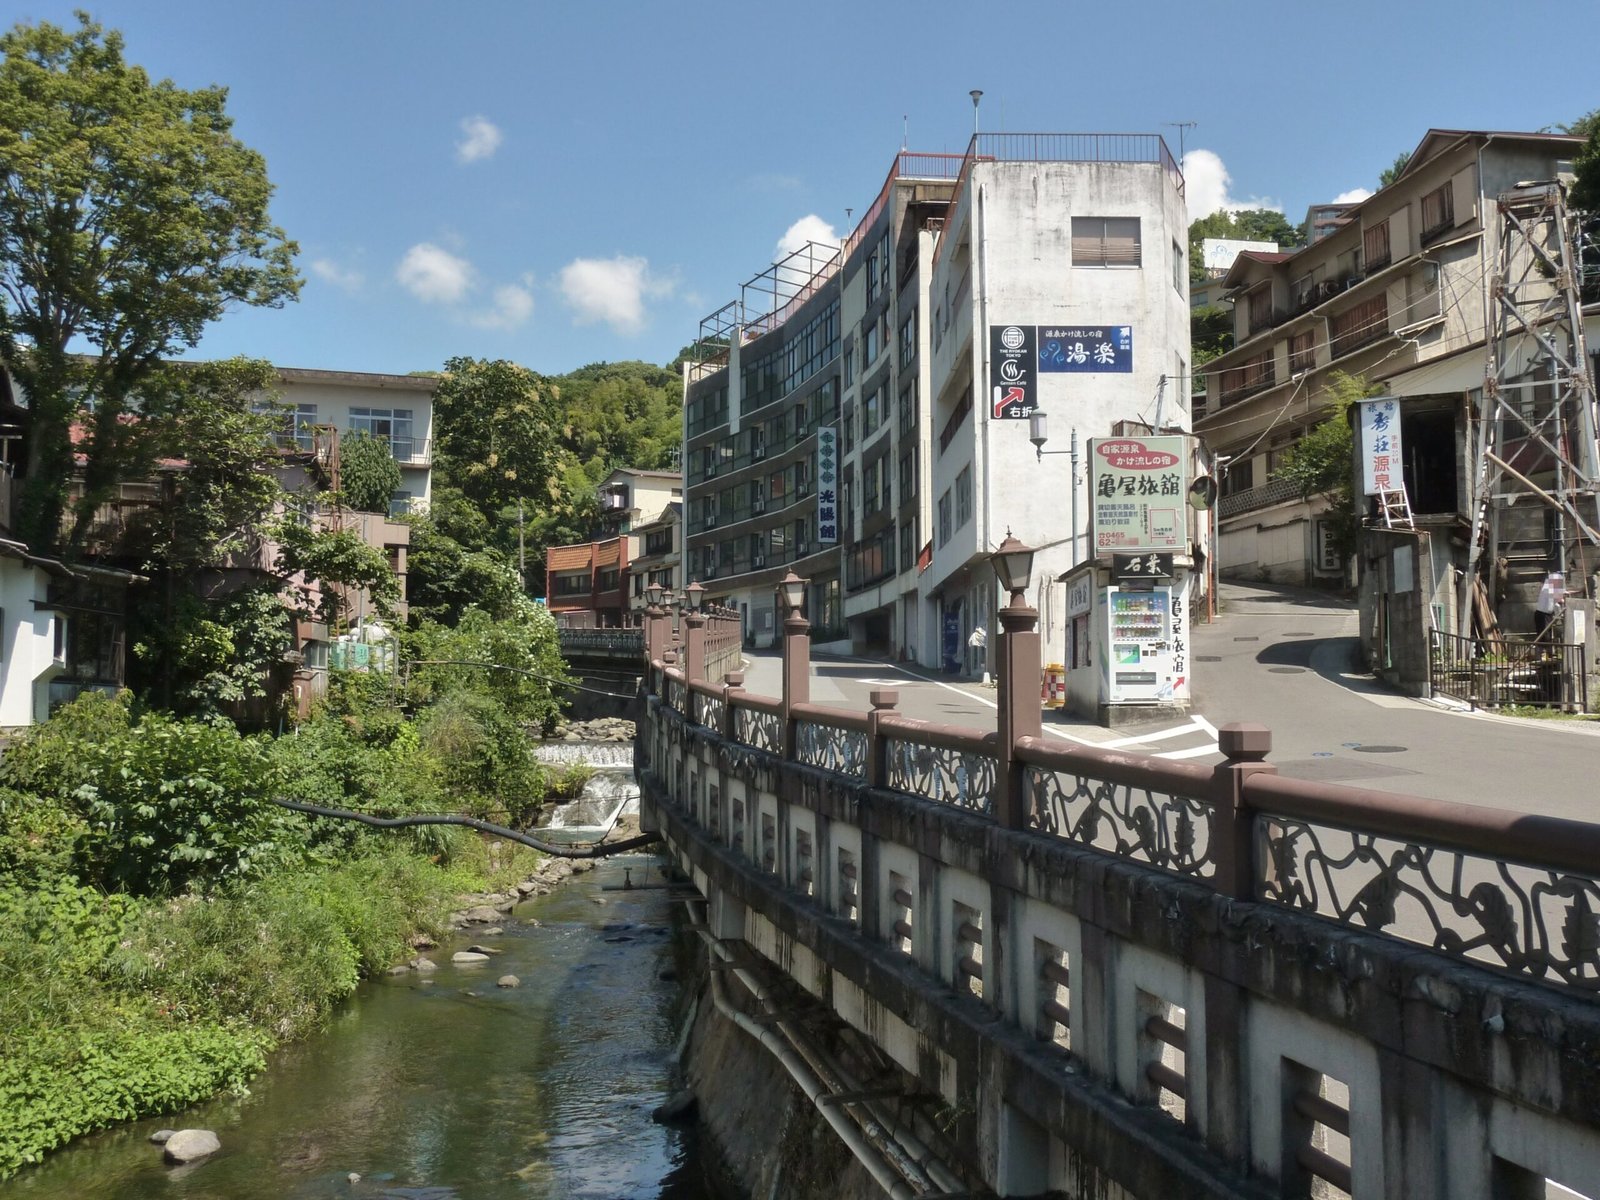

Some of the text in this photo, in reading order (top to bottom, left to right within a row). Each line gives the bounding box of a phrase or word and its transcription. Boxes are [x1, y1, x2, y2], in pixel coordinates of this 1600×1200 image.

[1045, 330, 1103, 338] 源泉かけ流しの宿
[1066, 342, 1115, 364] 湯楽
[1010, 407, 1032, 417] 右折
[1103, 445, 1139, 453] 自家源泉
[1117, 456, 1170, 465] かけ流しの宿
[1374, 455, 1390, 490] 源泉
[1098, 473, 1180, 497] 亀屋旅館
